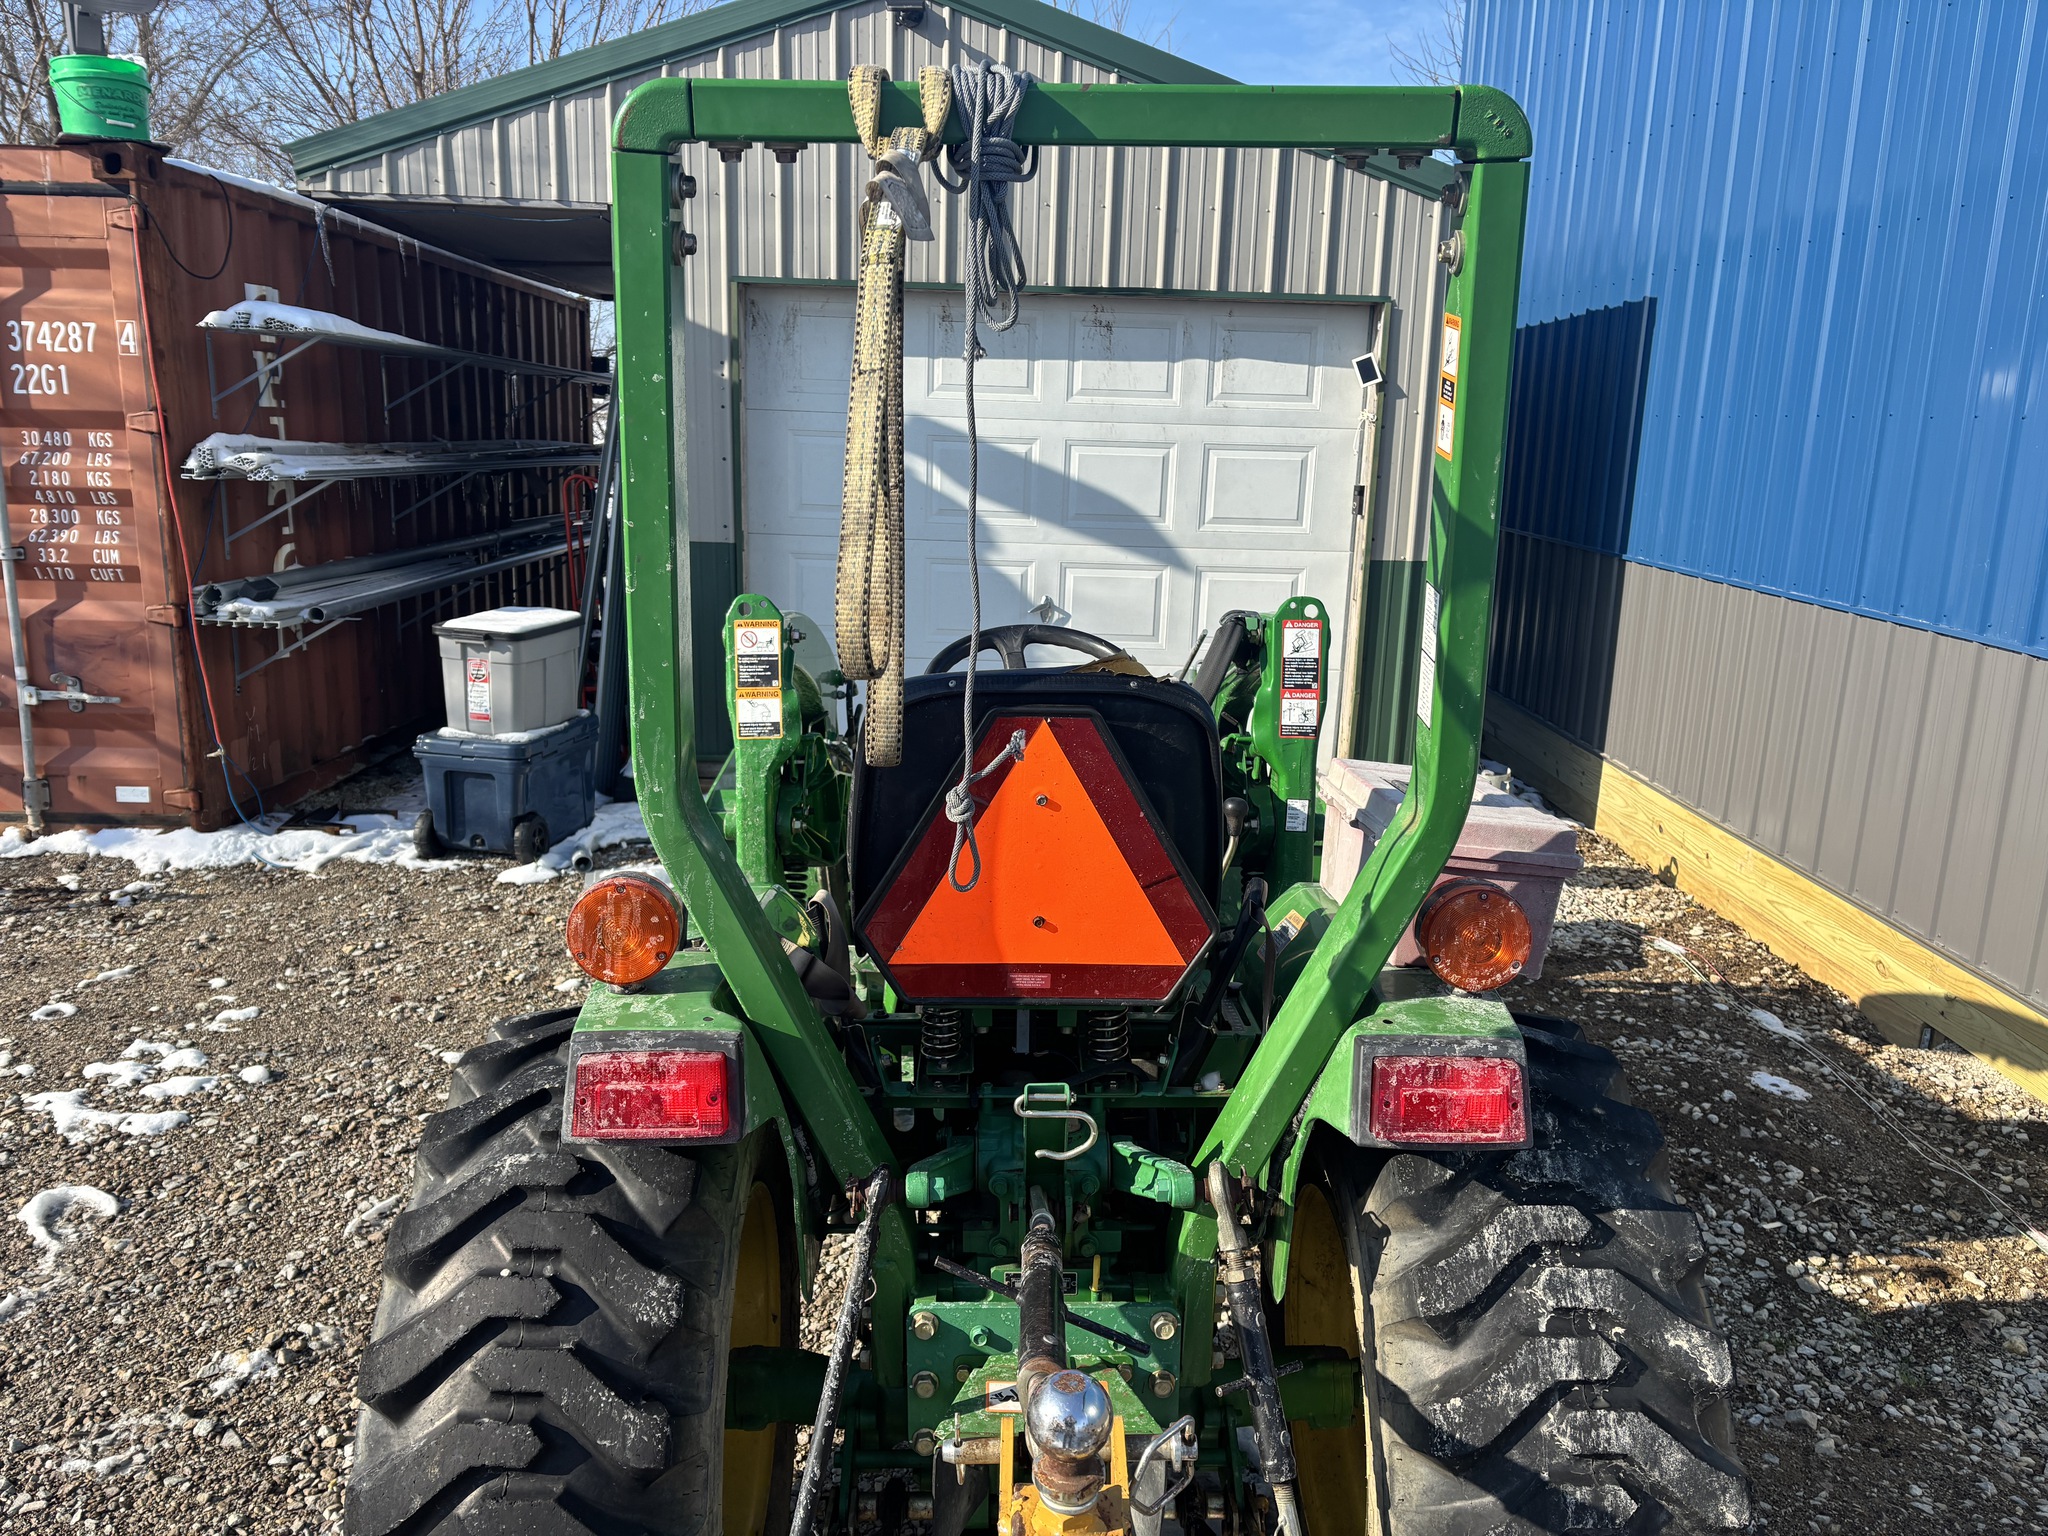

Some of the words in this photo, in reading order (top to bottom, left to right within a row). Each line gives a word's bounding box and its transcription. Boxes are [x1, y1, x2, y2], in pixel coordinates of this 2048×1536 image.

[6, 320, 97, 353] 374287
[120, 322, 136, 353] 4
[9, 363, 70, 395] 22G1
[21, 430, 72, 447] 30.480
[87, 431, 114, 447] KGS
[20, 451, 71, 466] 67.200
[86, 452, 112, 467] LBS
[29, 470, 70, 486] 2.180
[86, 471, 112, 487] KGS
[34, 490, 76, 504] 4.810
[89, 491, 117, 505] LBS
[29, 509, 80, 524] 28.300
[96, 510, 122, 525] KGS
[28, 529, 79, 544] 62.390
[94, 530, 120, 544] LBS
[38, 548, 69, 563] 33.2
[93, 548, 120, 564] CUM
[34, 566, 74, 580] 1.170
[90, 568, 124, 582] CUFT
[745, 690, 779, 698] WARNING
